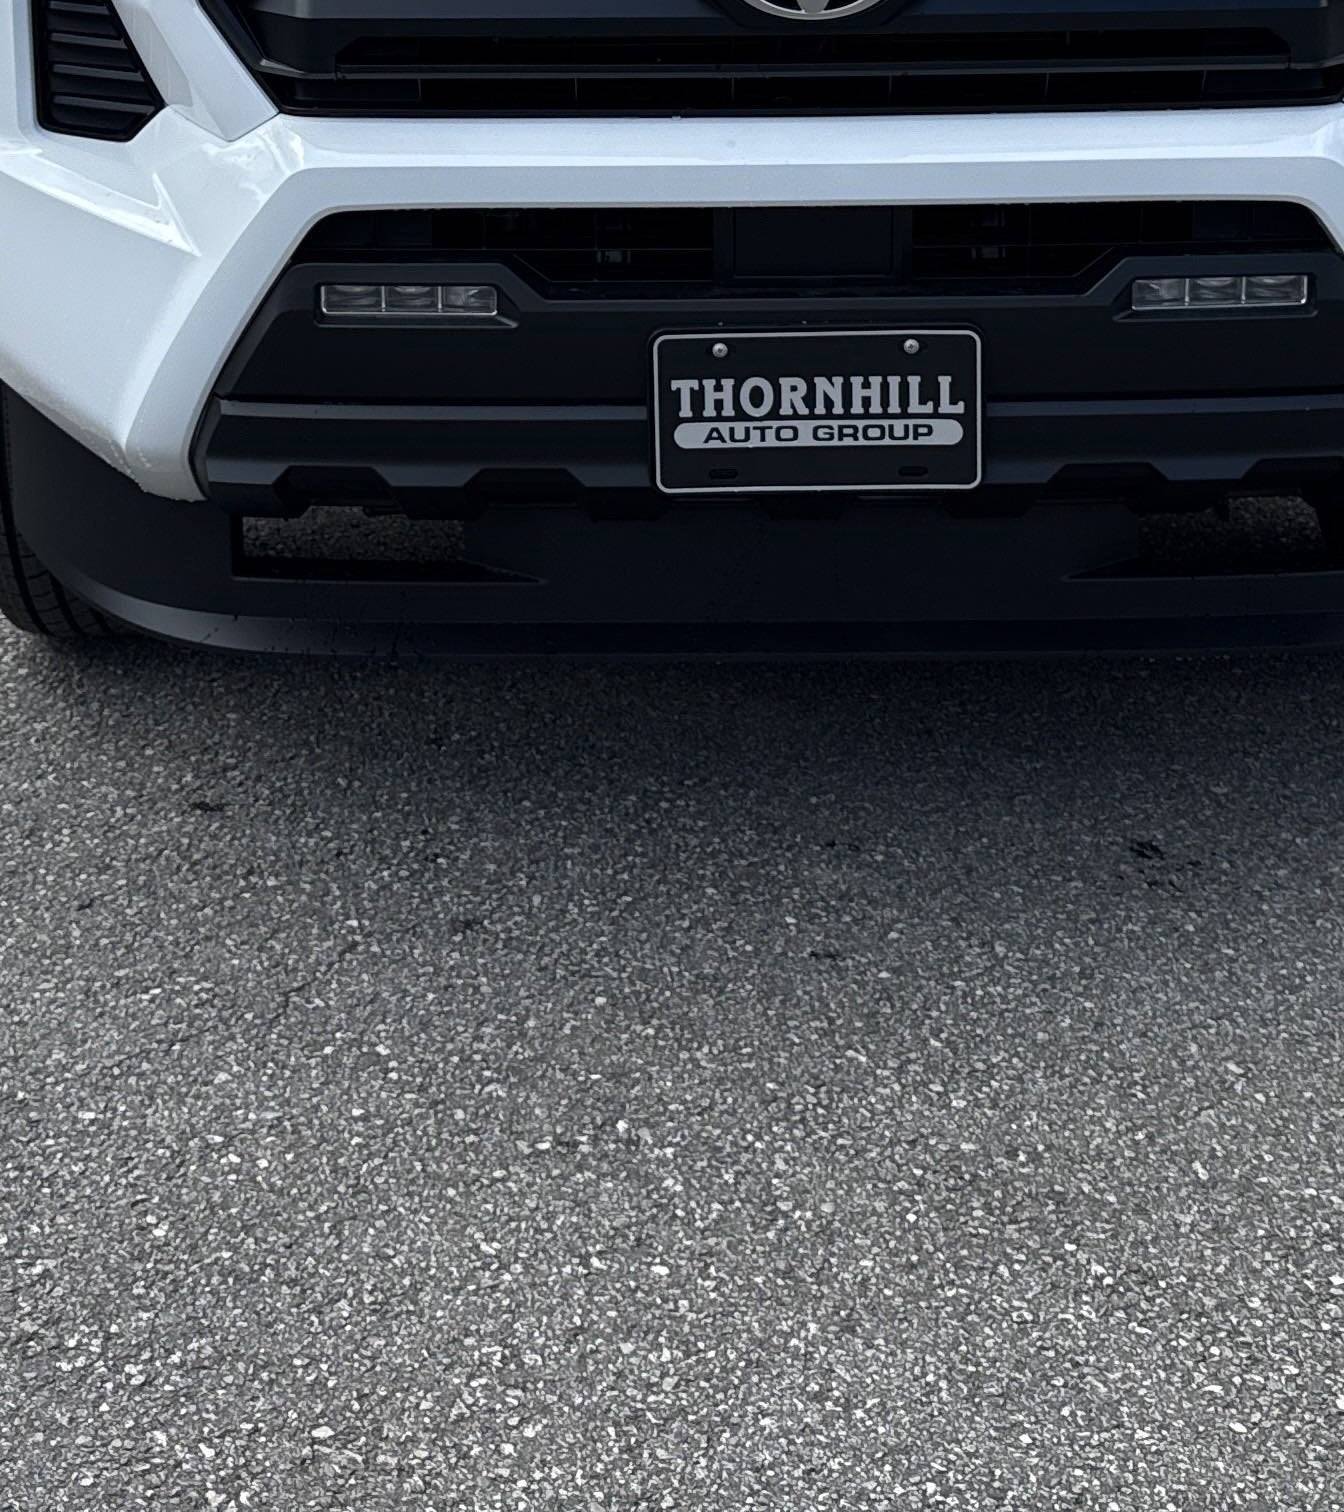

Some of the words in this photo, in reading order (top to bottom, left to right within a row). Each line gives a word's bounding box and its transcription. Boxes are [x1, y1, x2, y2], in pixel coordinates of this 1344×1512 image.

[671, 375, 965, 418] THORNHILL
[703, 425, 799, 444] AUTO
[812, 423, 934, 442] GROUP
